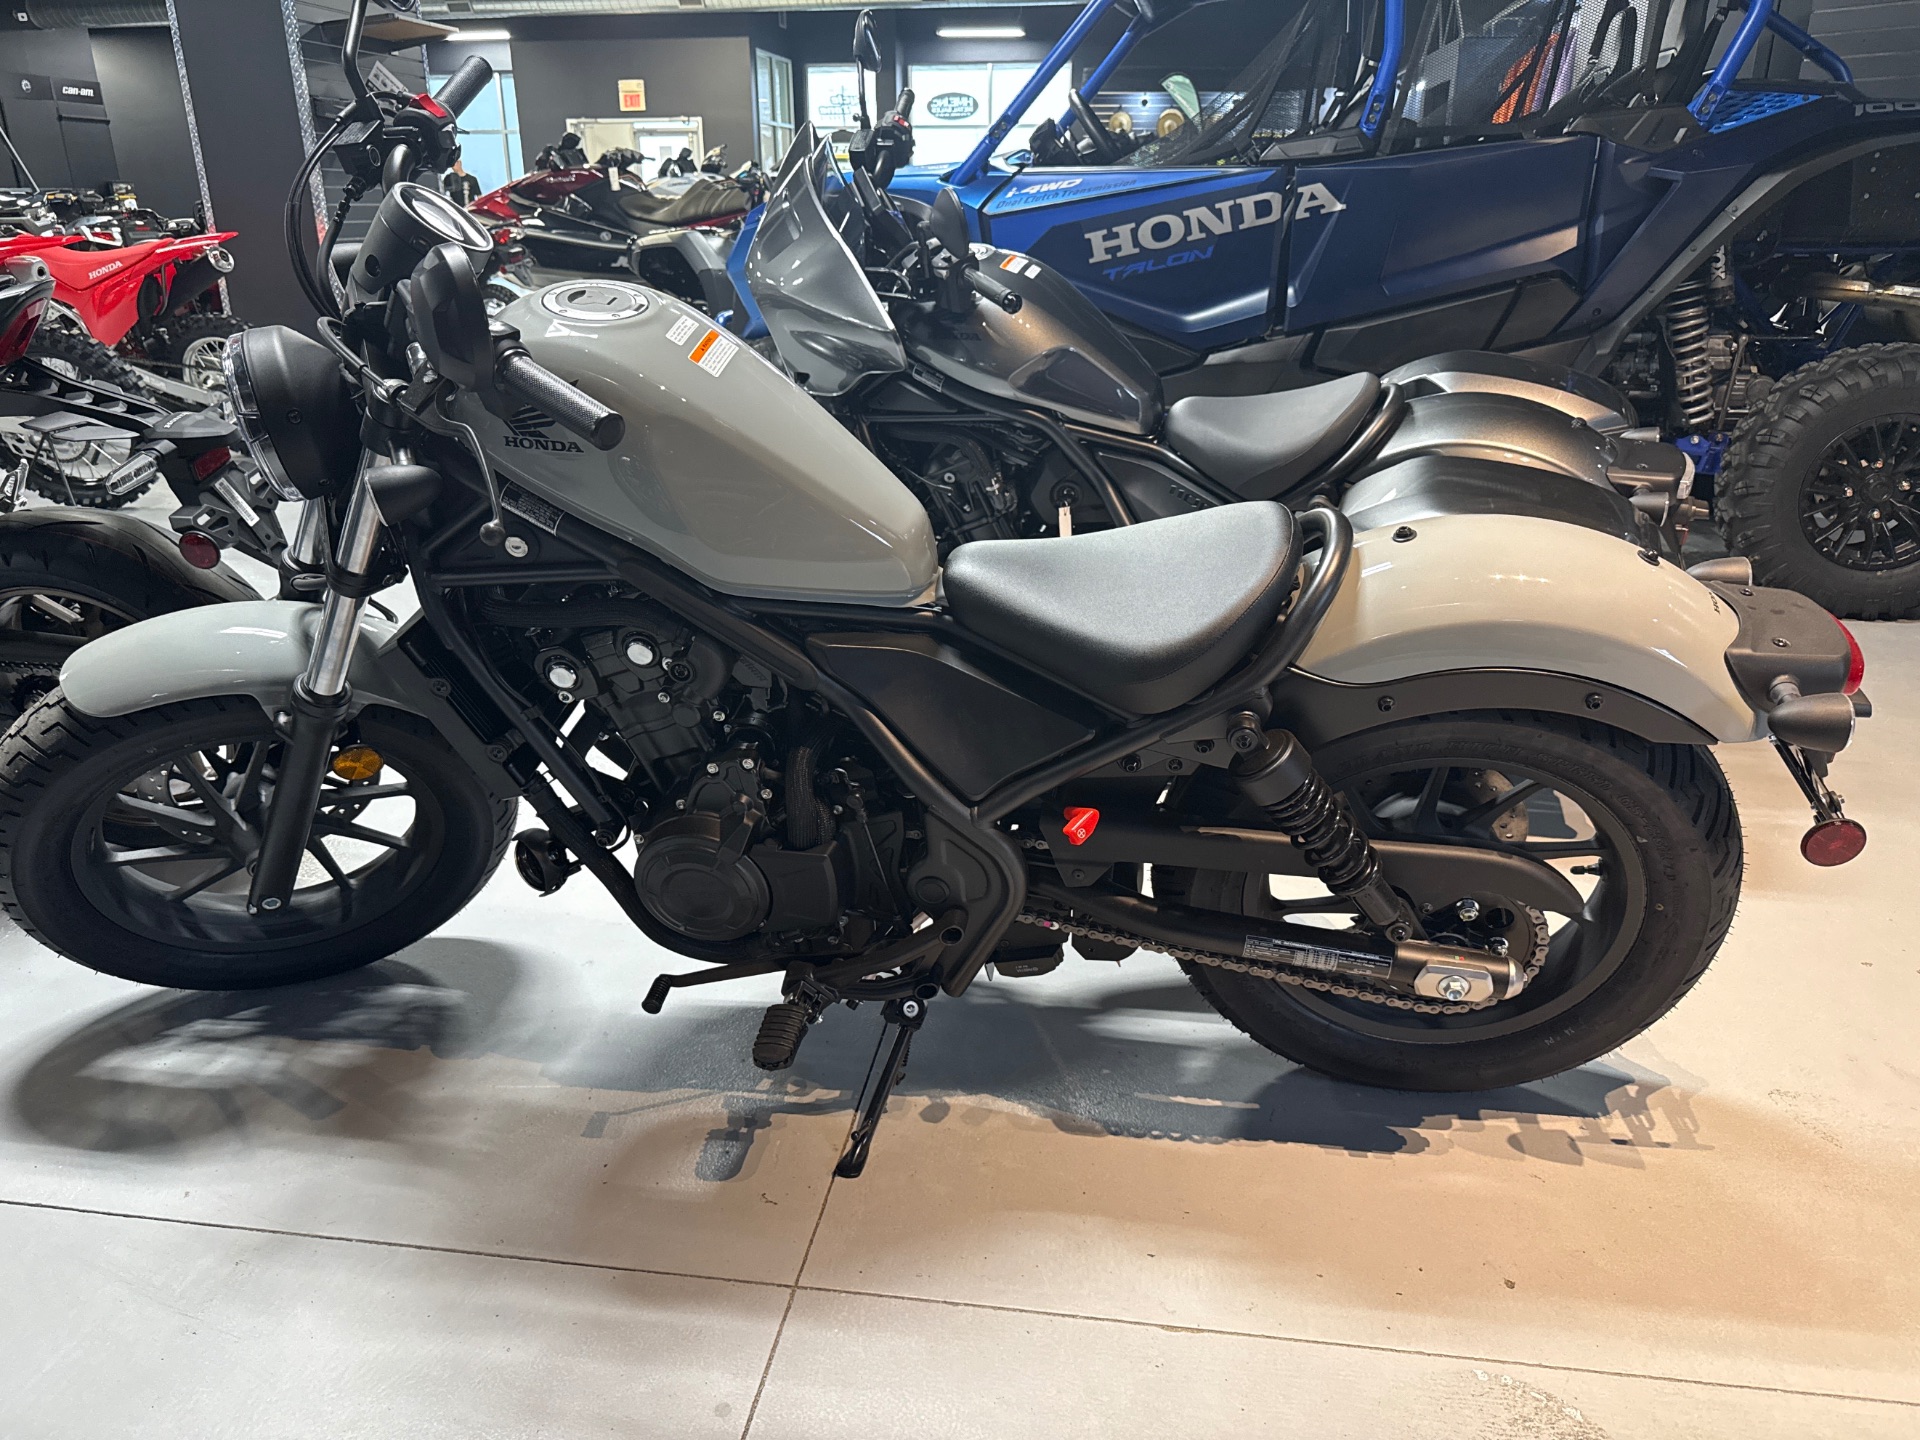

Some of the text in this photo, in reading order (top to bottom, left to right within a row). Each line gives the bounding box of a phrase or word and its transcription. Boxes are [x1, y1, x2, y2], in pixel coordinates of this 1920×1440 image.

[62, 86, 95, 97] can-am
[996, 179, 1138, 210] Dual Clutch Transmission
[1005, 178, 1083, 198] i-4WD
[1084, 182, 1347, 264] HONDA
[88, 260, 124, 280] HONDA
[1102, 245, 1214, 281] TALON
[503, 435, 585, 453] HONDA
